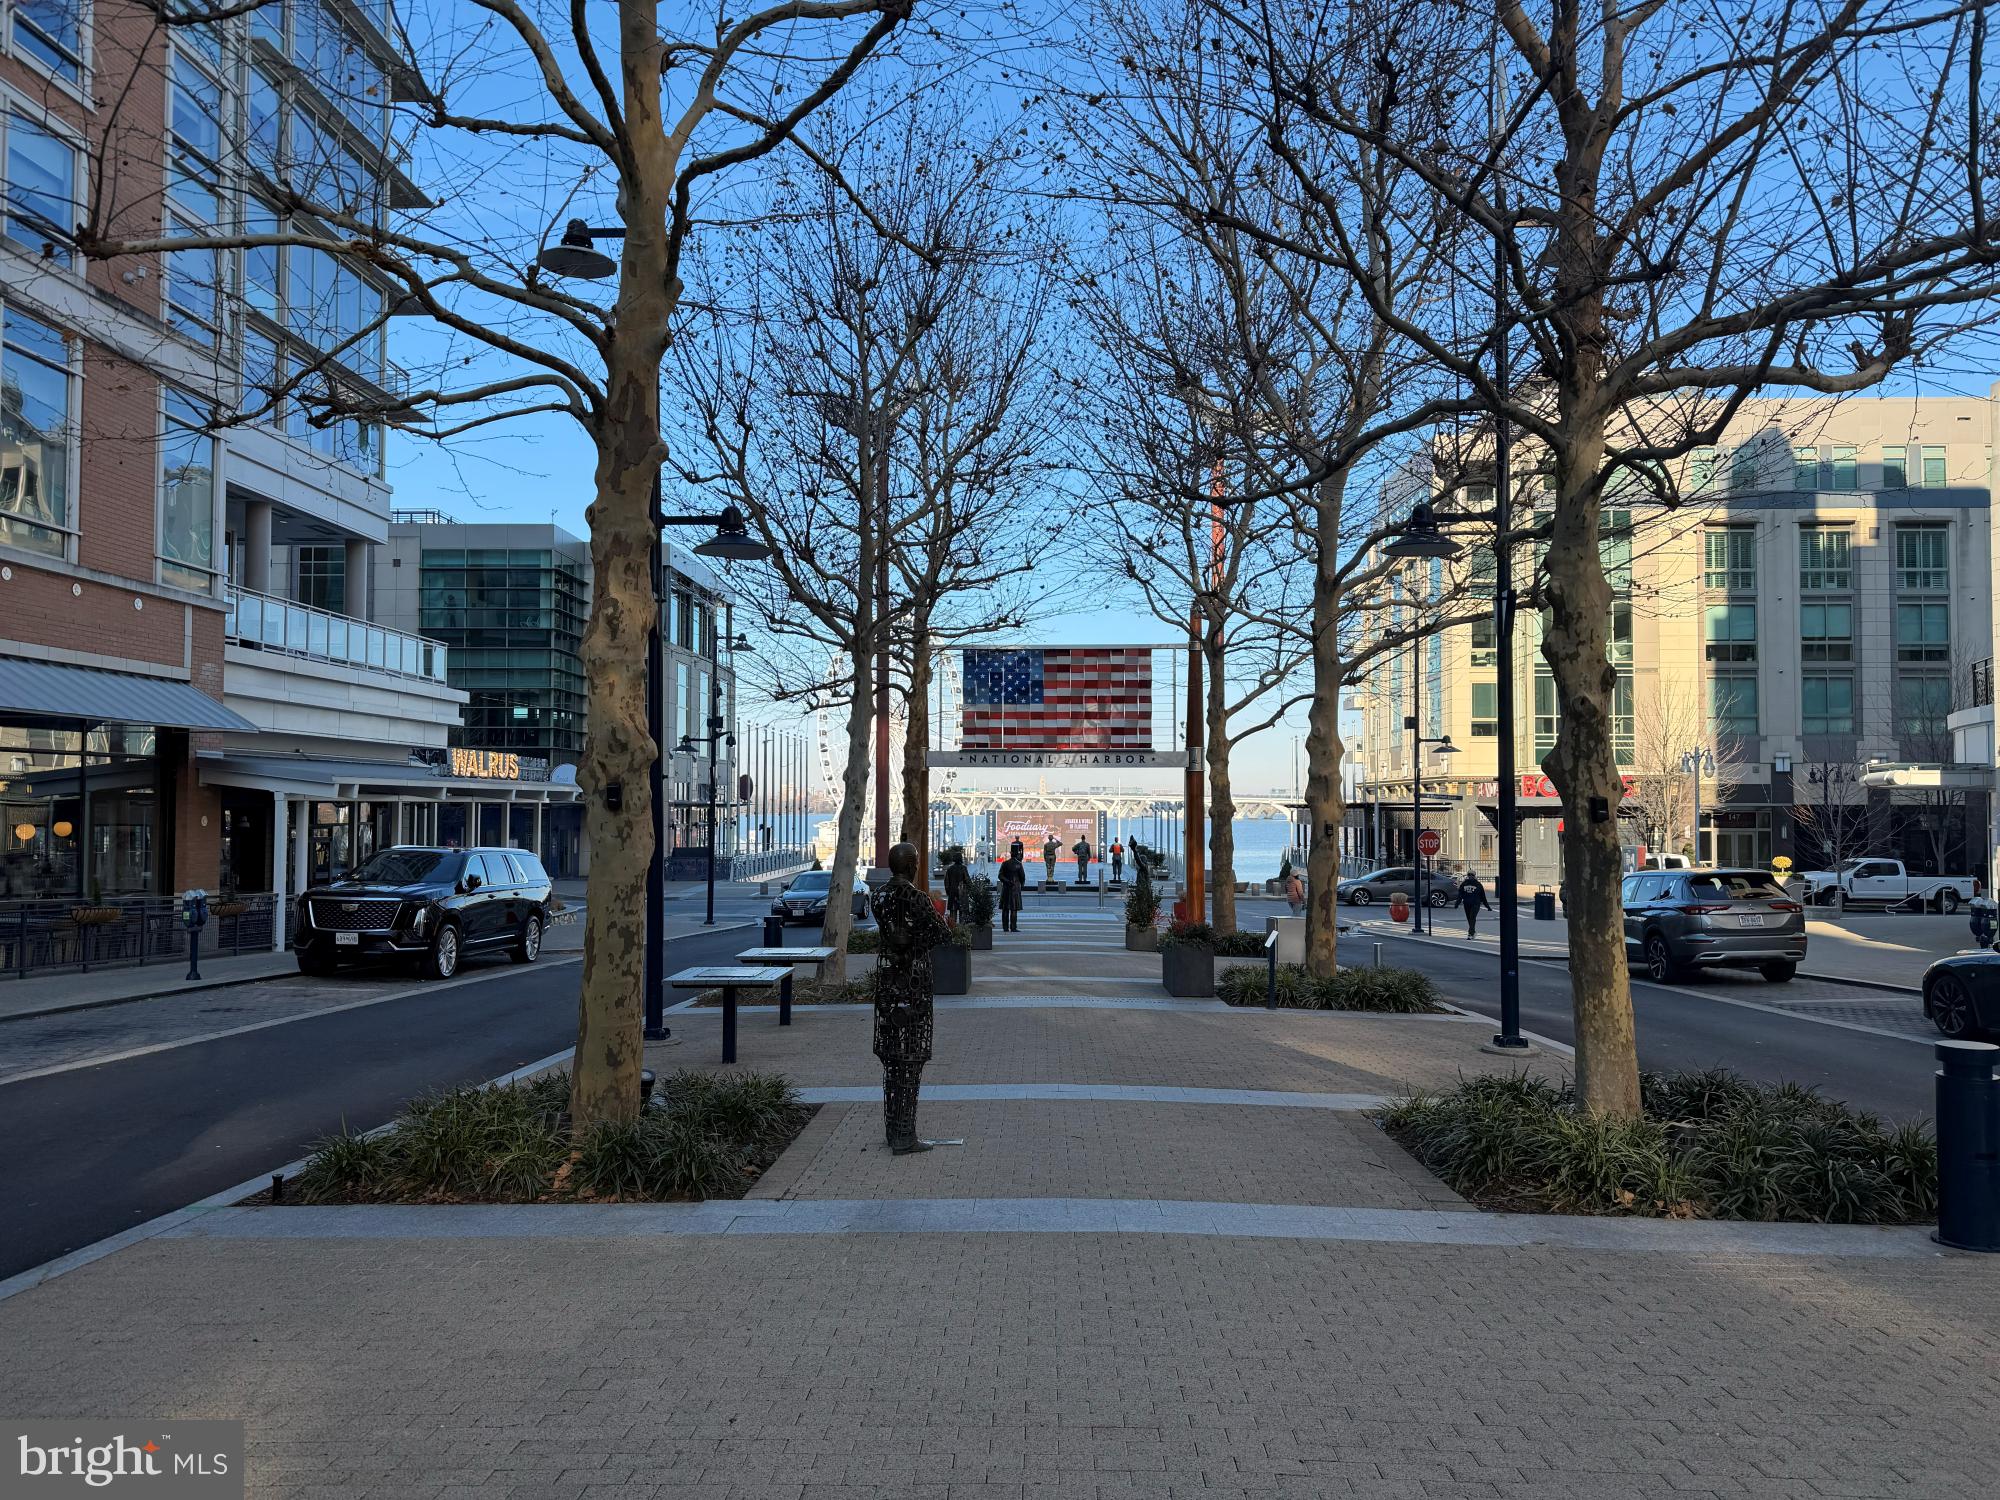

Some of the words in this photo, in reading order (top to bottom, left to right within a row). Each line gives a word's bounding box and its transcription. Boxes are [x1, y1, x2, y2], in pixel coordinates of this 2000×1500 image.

[452, 748, 519, 780] WALRUS
[969, 755, 1054, 764] NATIONAL
[1079, 755, 1147, 764] HARBOR
[1419, 839, 1440, 849] STOP
